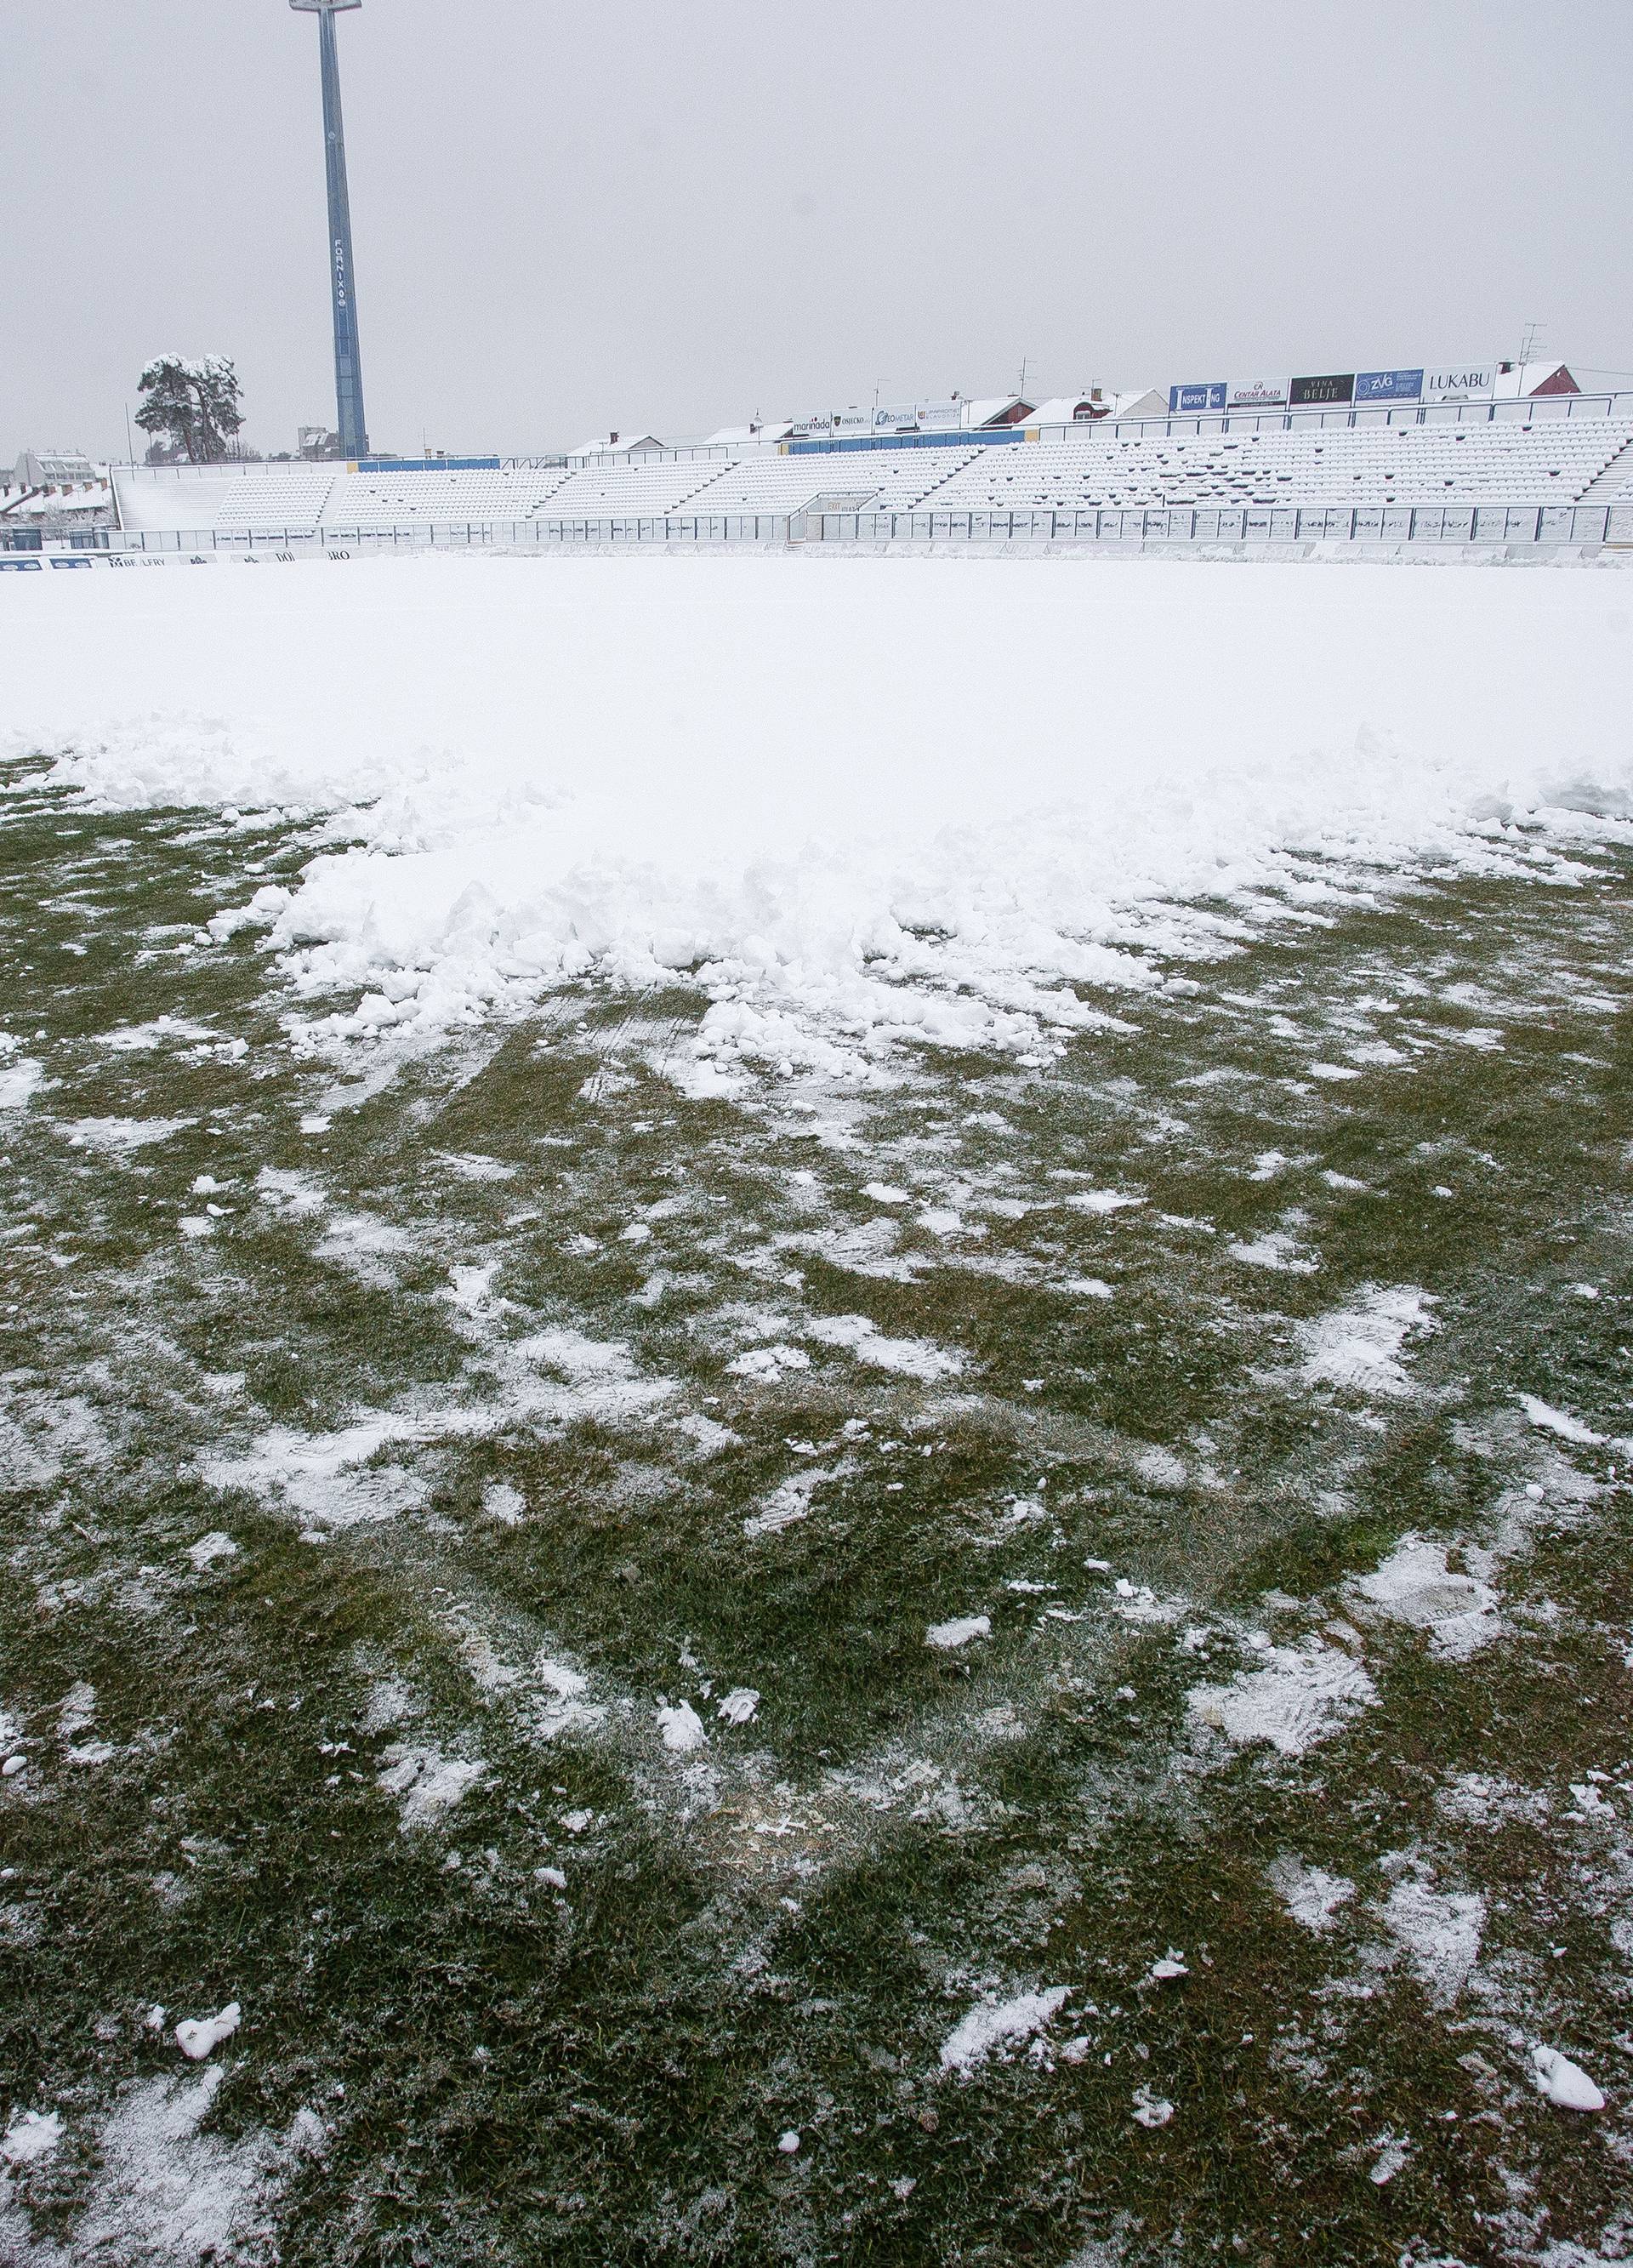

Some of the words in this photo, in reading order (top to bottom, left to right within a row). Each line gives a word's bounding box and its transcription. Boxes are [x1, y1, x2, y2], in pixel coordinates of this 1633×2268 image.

[1370, 373, 1393, 390] ZVG
[1430, 373, 1490, 390] LUKABU
[1234, 390, 1259, 399] CENTAR
[1260, 389, 1281, 397] ALATA
[1304, 388, 1338, 401] BELJE
[794, 418, 830, 431] marinada
